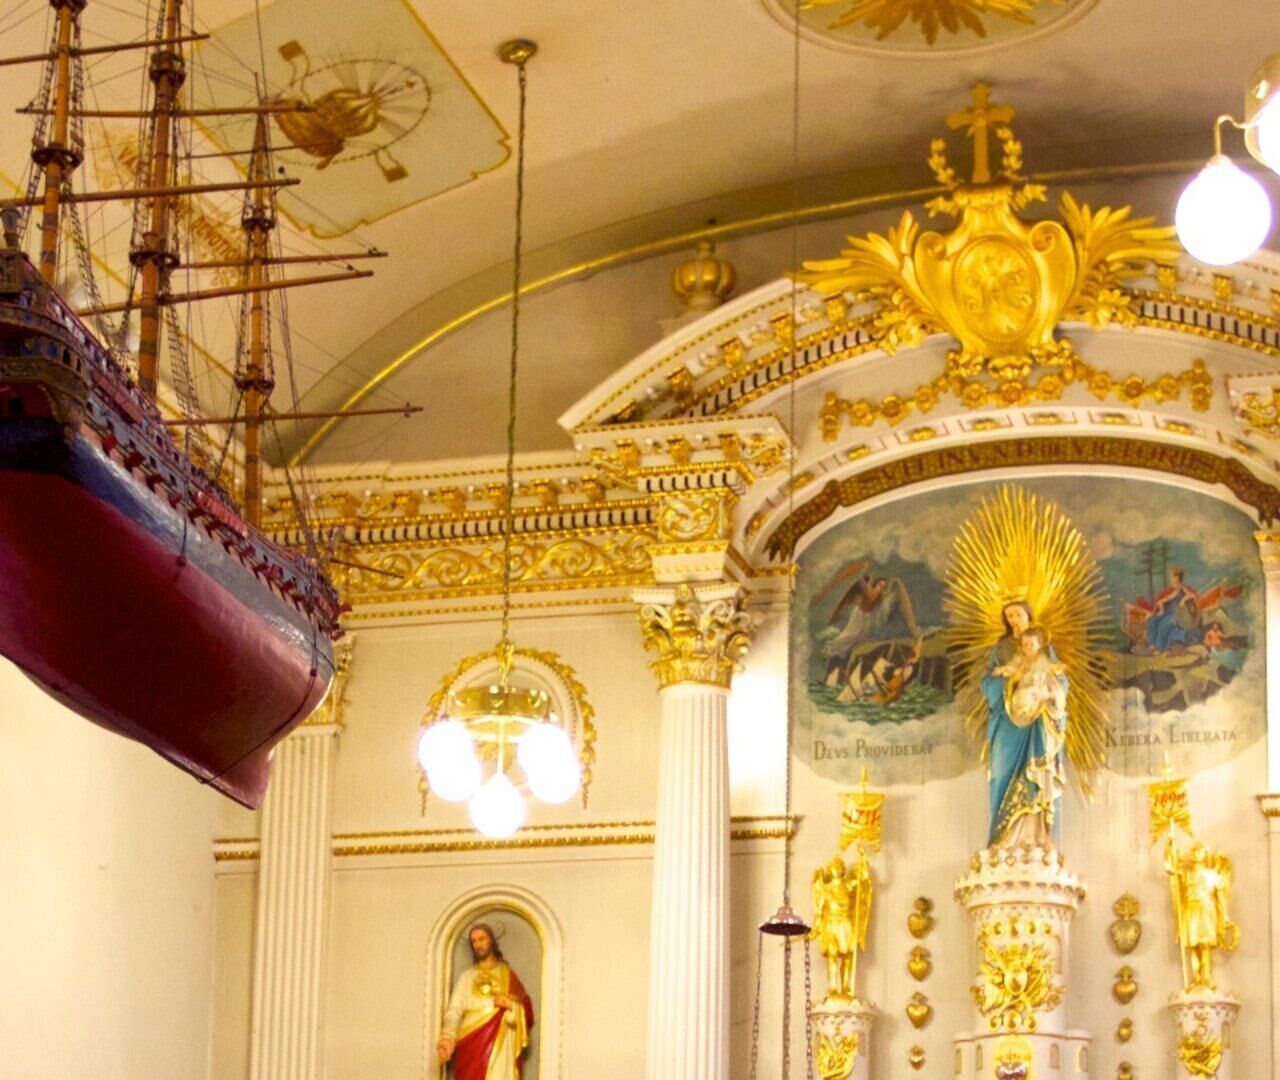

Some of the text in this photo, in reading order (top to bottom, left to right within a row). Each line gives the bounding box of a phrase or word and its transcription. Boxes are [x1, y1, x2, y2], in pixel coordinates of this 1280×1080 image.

[1169, 723, 1237, 744] LIBERATA
[814, 738, 933, 760] DEVS PROVIDEBAT
